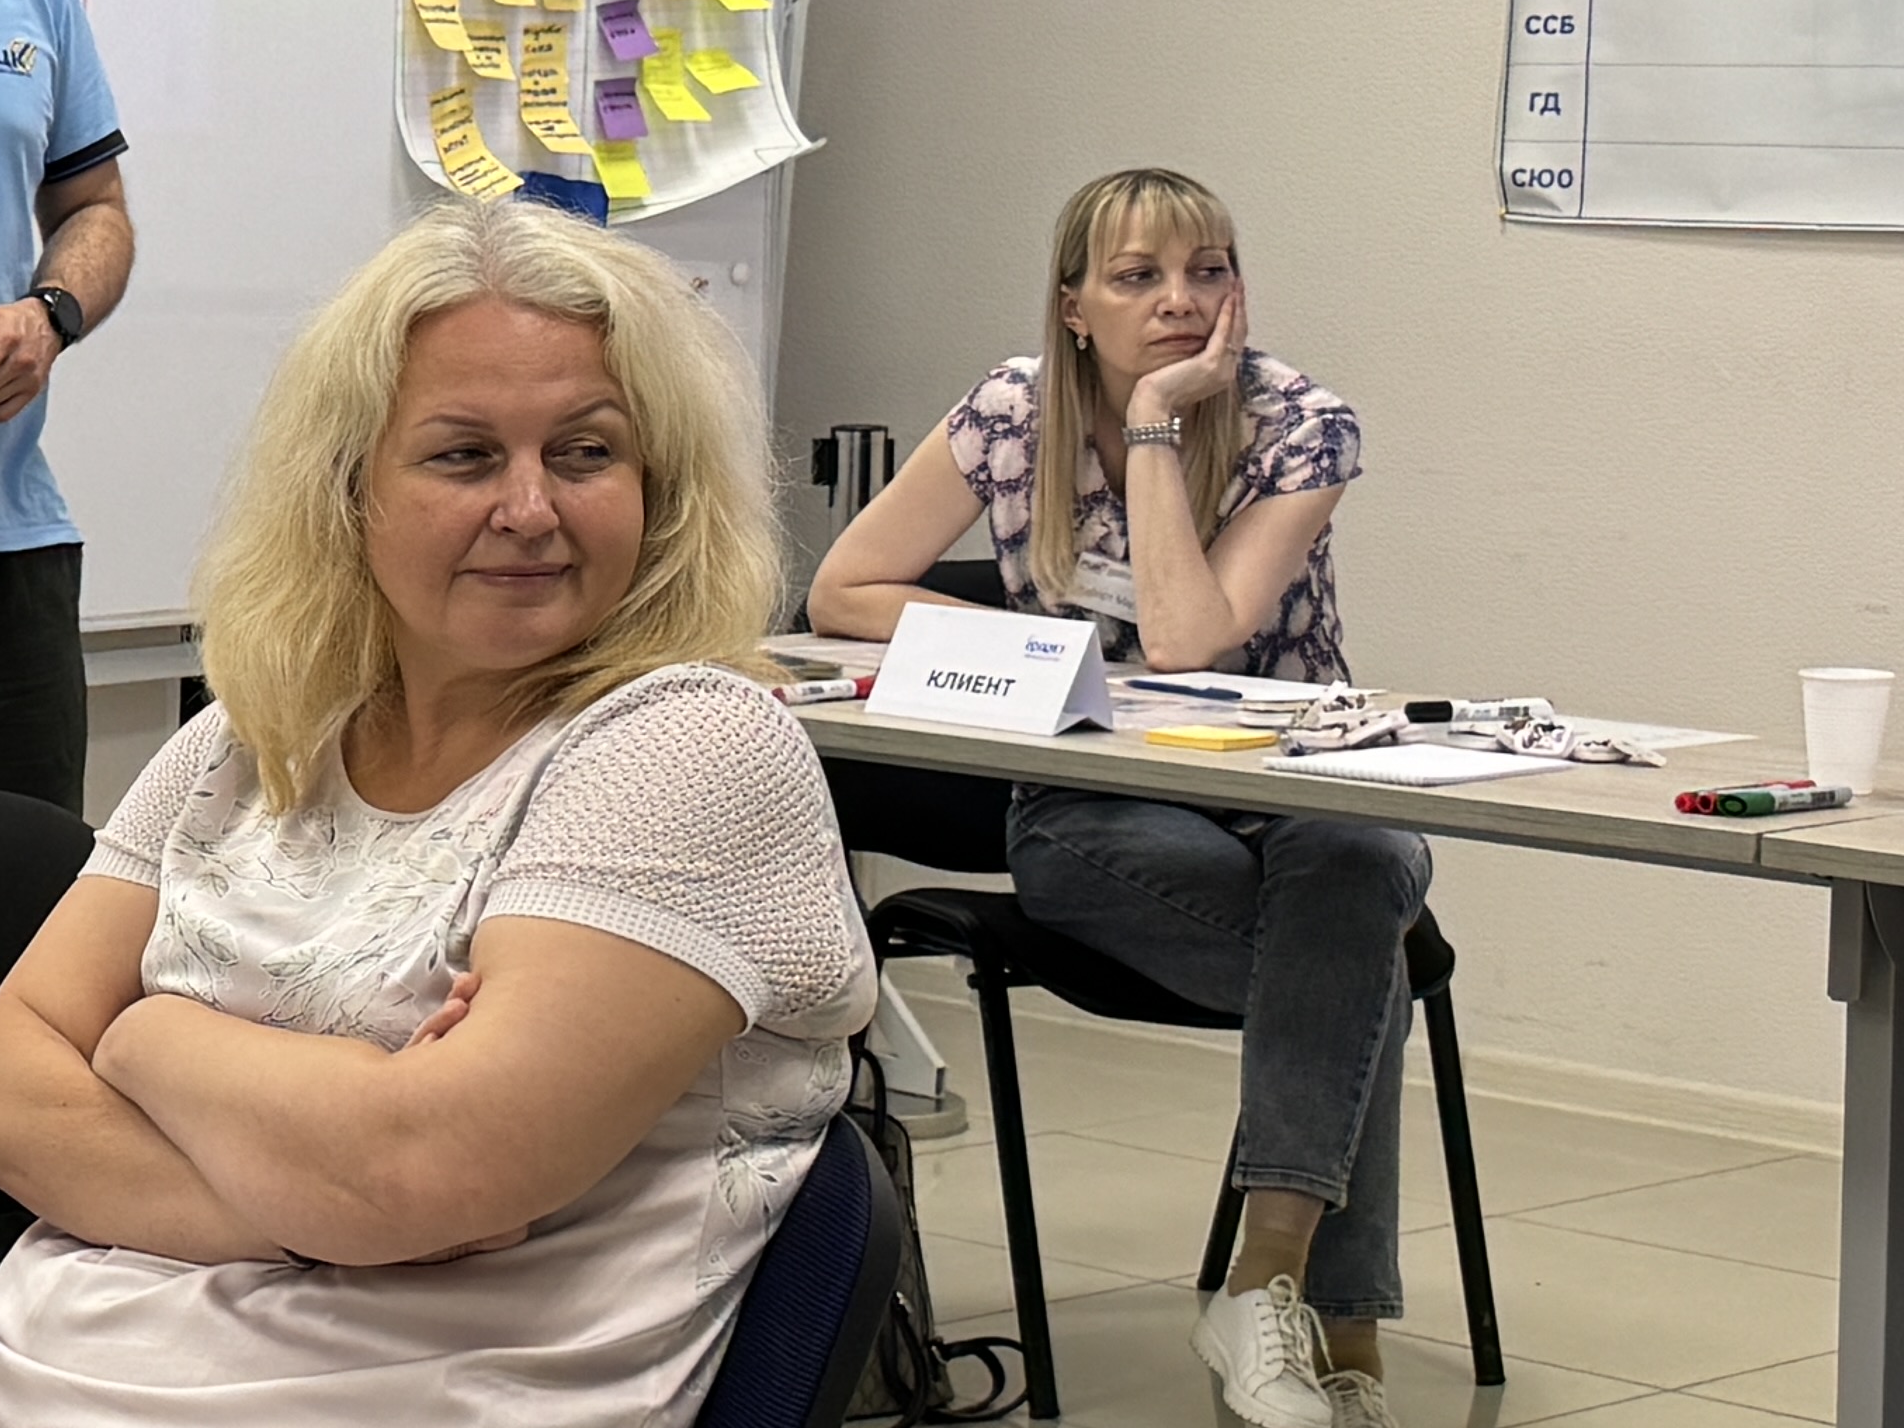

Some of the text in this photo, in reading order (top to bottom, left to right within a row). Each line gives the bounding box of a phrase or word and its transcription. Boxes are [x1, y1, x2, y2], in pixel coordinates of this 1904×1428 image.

[1523, 13, 1577, 37] ССБ
[1528, 91, 1563, 117] ГД
[1509, 167, 1575, 190] СЮО
[926, 668, 1017, 698] КЛИЕНТ
